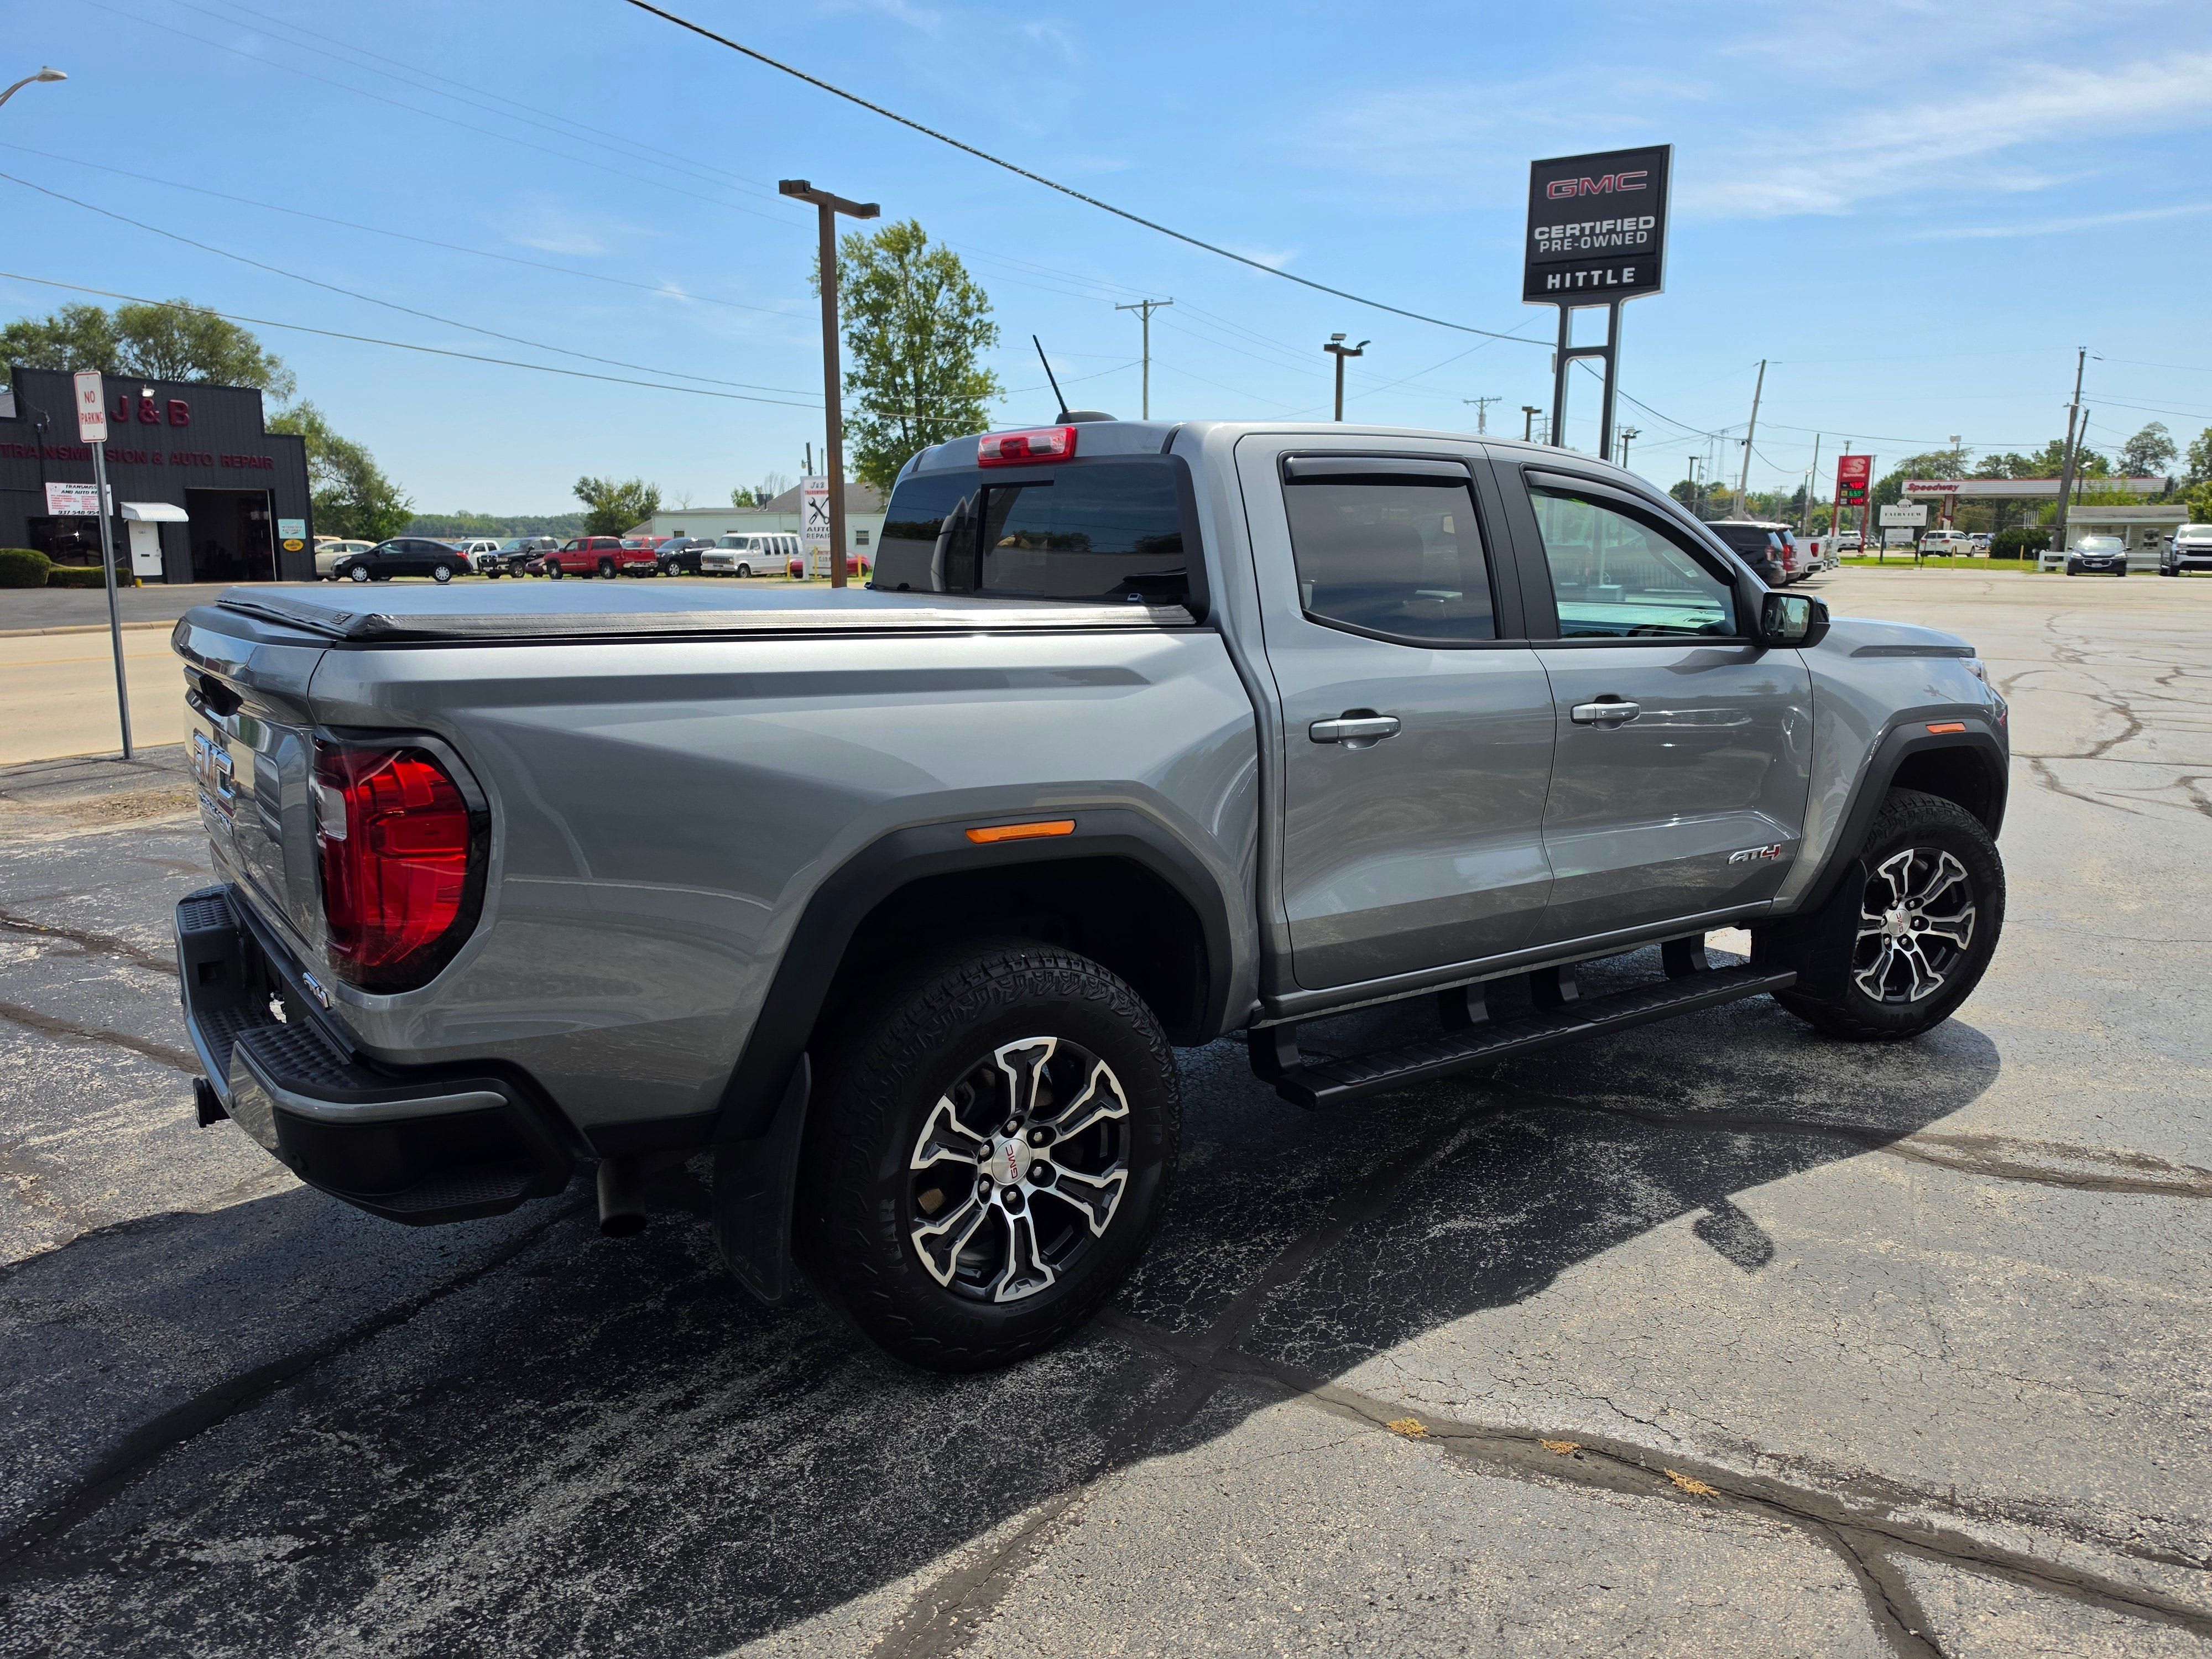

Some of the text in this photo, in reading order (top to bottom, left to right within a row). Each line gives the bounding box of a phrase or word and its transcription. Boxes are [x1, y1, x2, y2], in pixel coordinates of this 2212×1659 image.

[1547, 170, 1648, 200] GMC
[1534, 216, 1655, 240] CERTIFIED
[1540, 231, 1647, 253] PRE-OWNED
[1547, 267, 1635, 289] HITTLE
[84, 390, 95, 404] NO
[81, 412, 104, 425] PARKING
[152, 450, 163, 465] &
[170, 451, 213, 467] AUTO
[221, 453, 273, 470] REPAIR
[1907, 483, 1960, 492] Speedway
[1726, 844, 1781, 864] AT4
[1005, 1144, 1020, 1180] GMC
